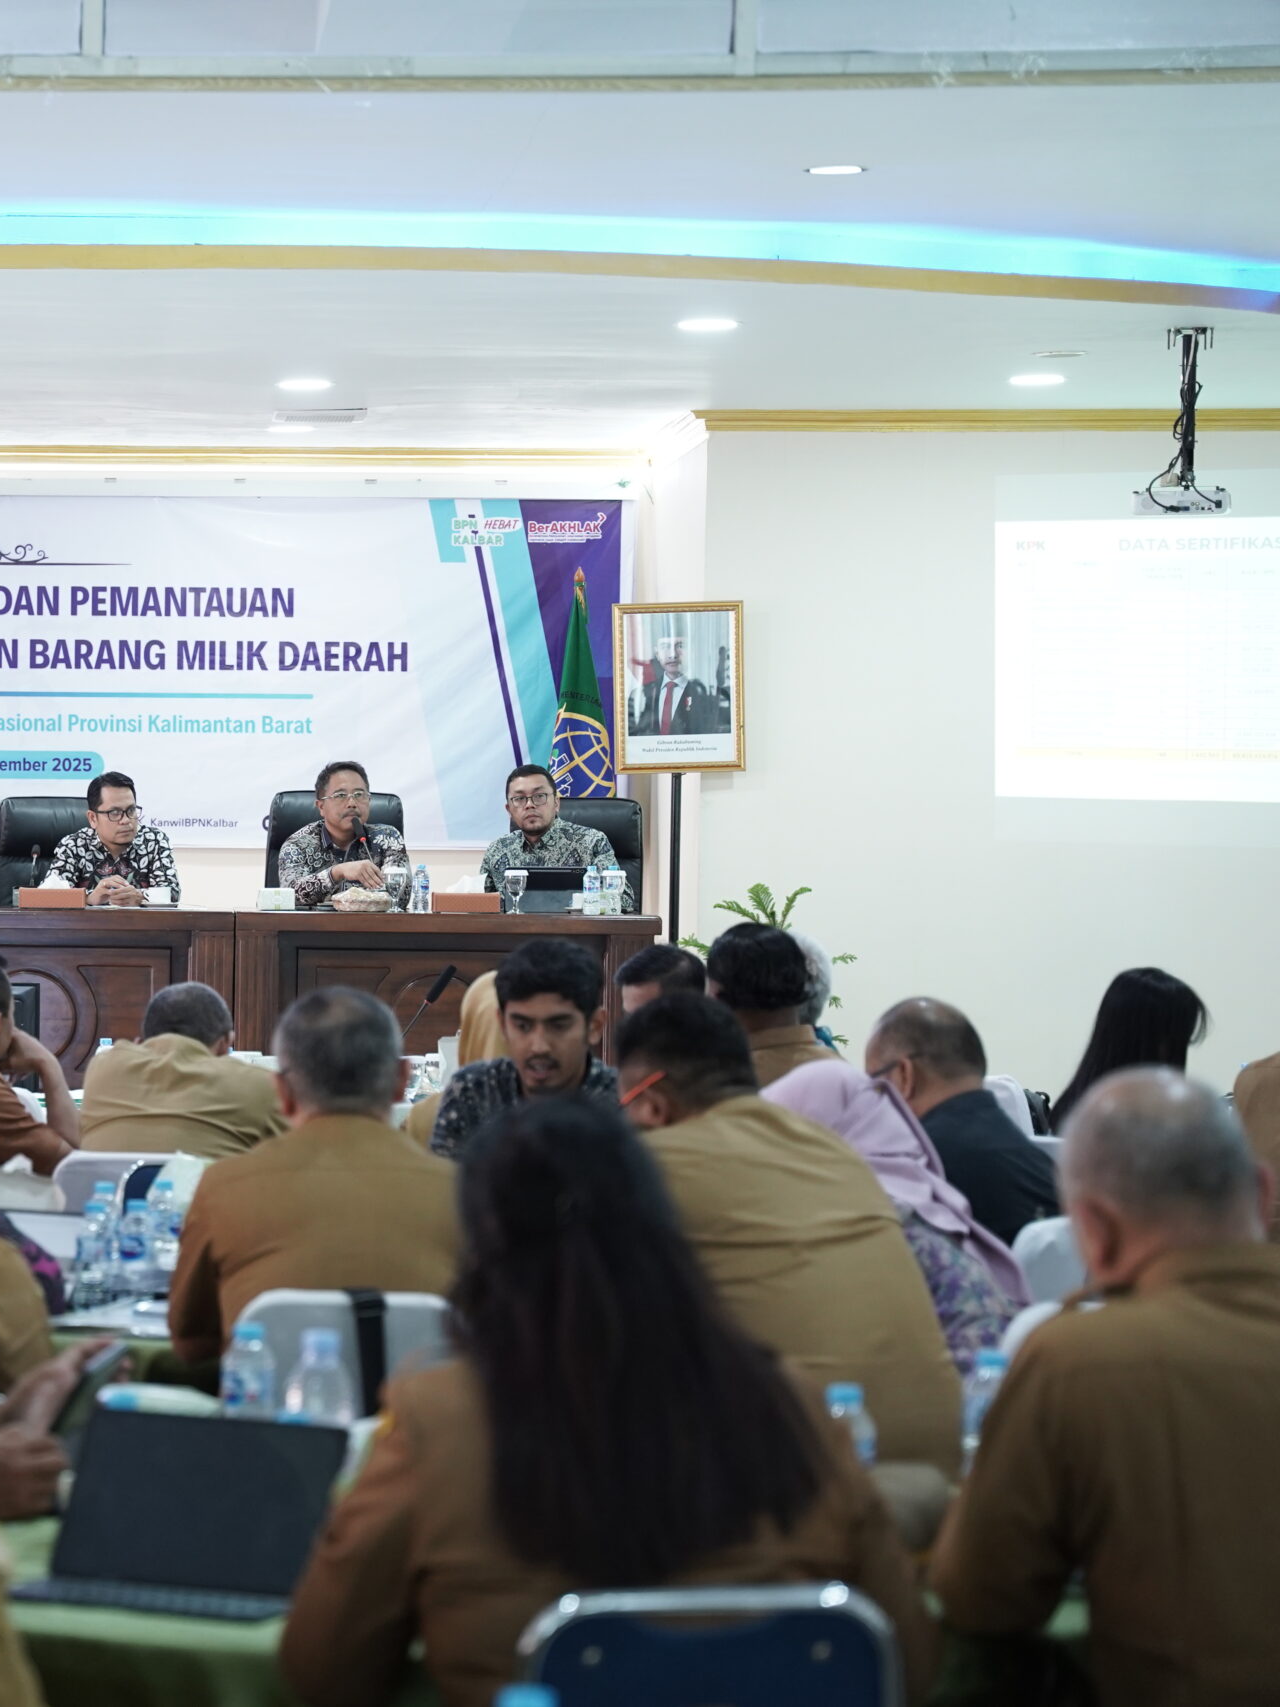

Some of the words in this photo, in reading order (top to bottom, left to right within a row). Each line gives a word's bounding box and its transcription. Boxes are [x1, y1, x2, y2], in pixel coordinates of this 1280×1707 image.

[453, 519, 478, 530] BPN
[484, 519, 519, 530] HEBAT
[528, 521, 601, 533] BerAKHLAK
[453, 534, 503, 545] KALBAR
[1015, 540, 1046, 551] KPK
[1118, 538, 1171, 551] DATA
[71, 586, 294, 617] PEMANTAUAN
[30, 639, 165, 670] BARANG
[177, 640, 268, 670] MILIK
[279, 642, 407, 672] DAERAH
[68, 714, 142, 732] Provinsi
[148, 714, 257, 733] Kalimantan
[261, 715, 312, 734] Barat
[52, 757, 92, 772] 2025
[150, 817, 238, 828] KanwilBPNKalbar
